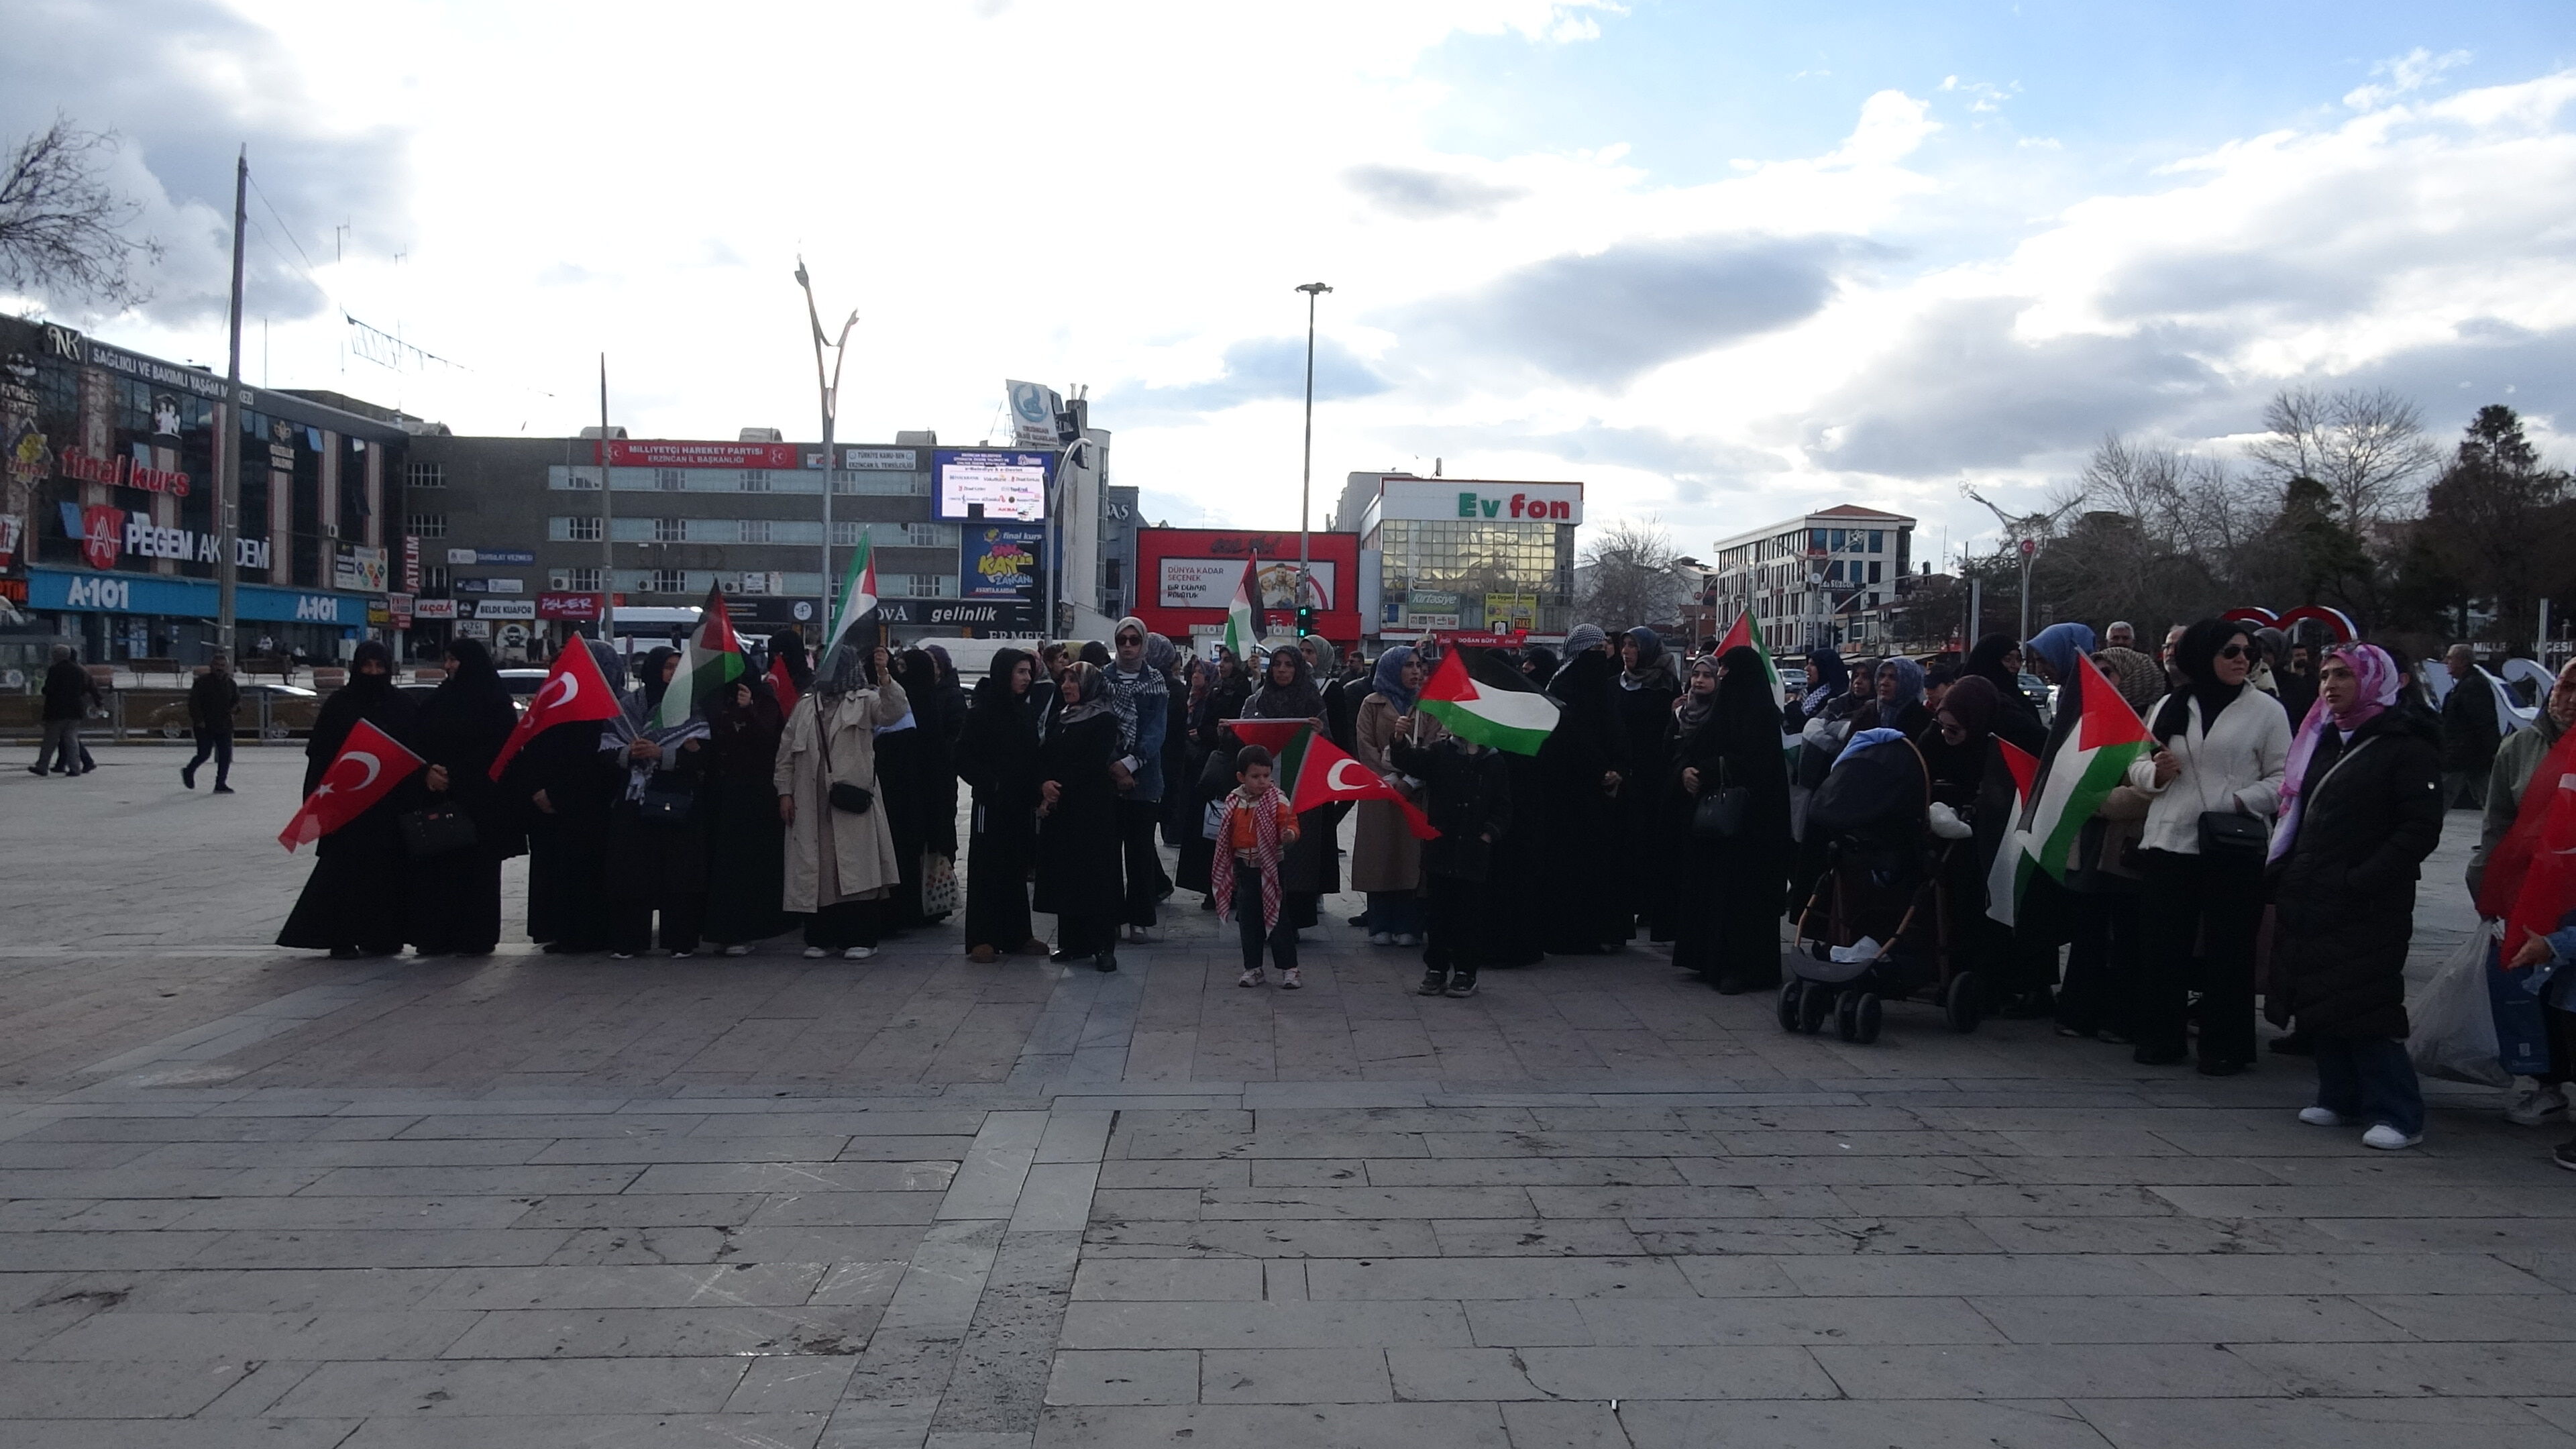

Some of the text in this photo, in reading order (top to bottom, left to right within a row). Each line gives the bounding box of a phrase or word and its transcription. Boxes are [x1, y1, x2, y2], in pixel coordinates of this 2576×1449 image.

[93, 347, 136, 373] SAĞLIKLI
[138, 361, 150, 377] VE
[152, 366, 188, 387] BAKIMLI
[190, 376, 219, 396] YAŞAM
[629, 445, 763, 455] MİLLİYETÇİ HAREKET PARTİSİ
[648, 454, 687, 462] ERZİNCAN
[697, 455, 744, 464] BAŞKANLIĞI
[61, 445, 126, 486] final
[129, 456, 191, 496] kurs
[126, 523, 270, 569] PEGEM AKDEMİ
[407, 535, 420, 588] ATILIM
[1168, 566, 1195, 574] DÜNYA
[1168, 574, 1201, 582] SEÇENEK
[1181, 584, 1206, 592] DÜNYA
[1412, 593, 1456, 605] Kırtasiye
[480, 605, 532, 614] BELDE KUAFÖR
[930, 606, 998, 623] gelinlik
